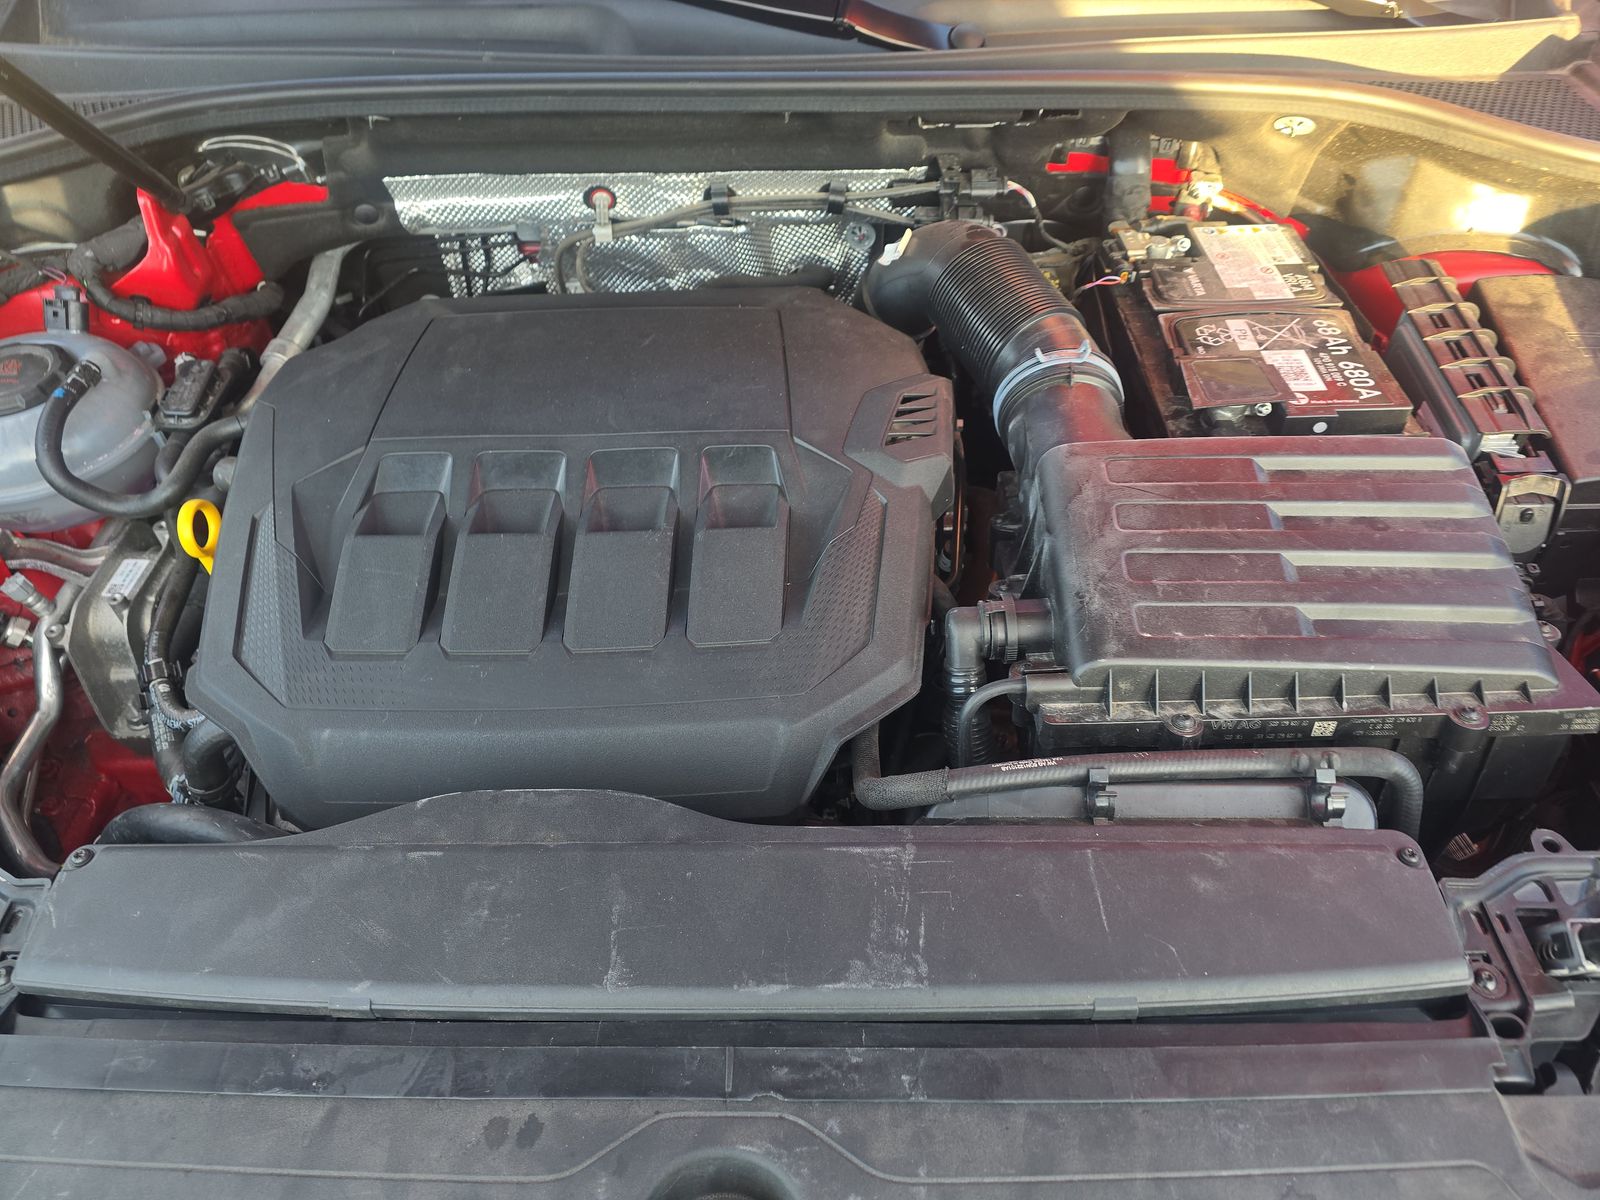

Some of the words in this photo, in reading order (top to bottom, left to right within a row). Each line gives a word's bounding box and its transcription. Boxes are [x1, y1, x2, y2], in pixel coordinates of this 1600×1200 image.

[1187, 273, 1207, 296] VARTA
[1282, 272, 1303, 293] VRLA
[1293, 274, 1317, 291] AGM
[1233, 328, 1248, 341] Pb
[1312, 319, 1353, 355] 68Ah
[1338, 361, 1382, 400] 680A
